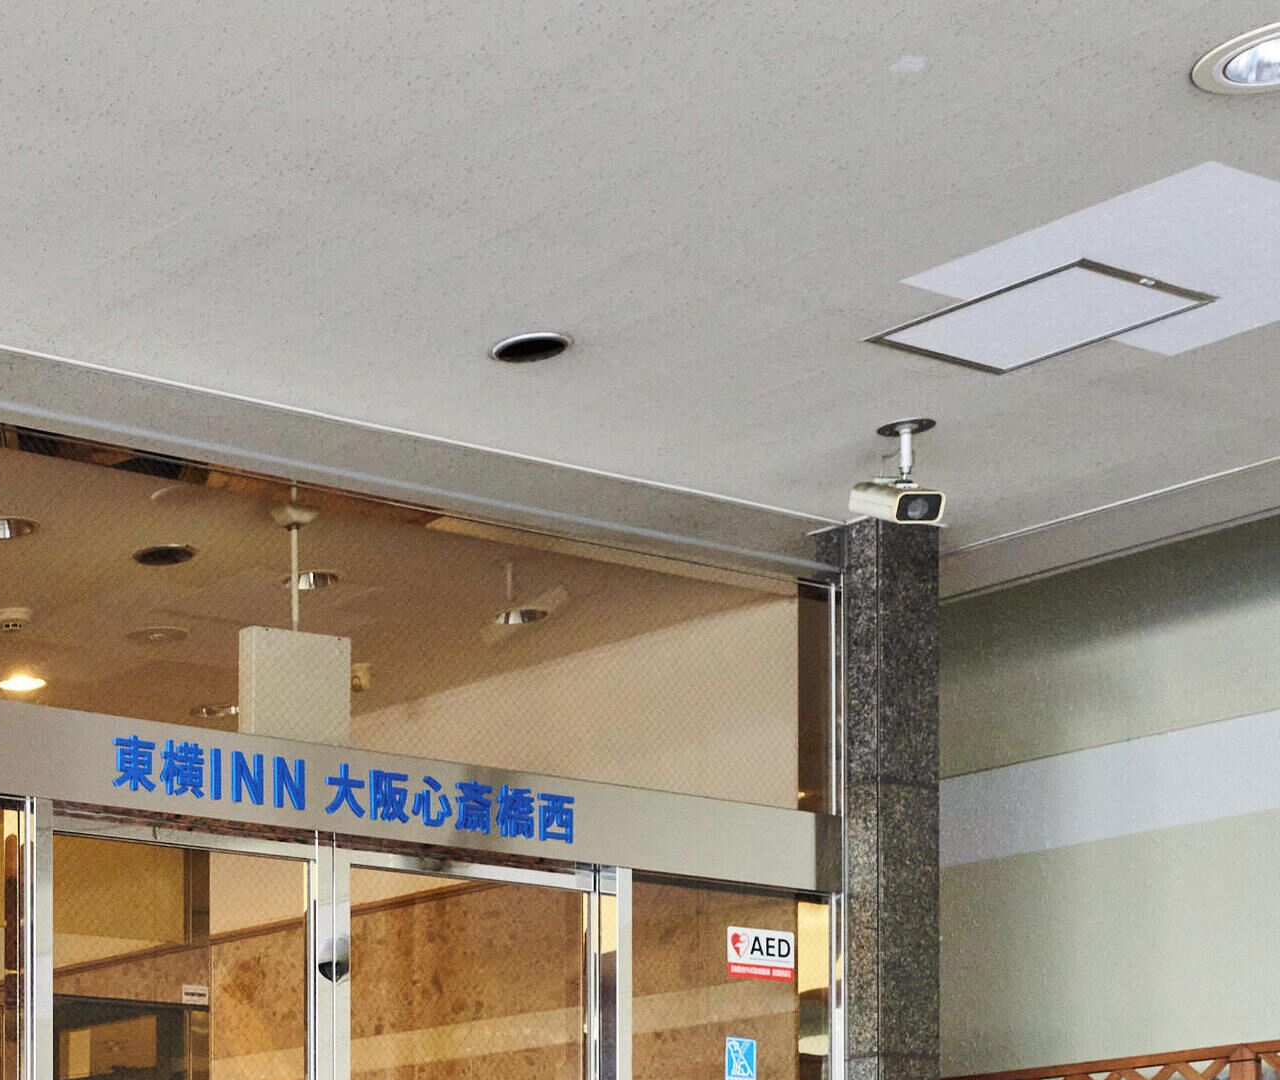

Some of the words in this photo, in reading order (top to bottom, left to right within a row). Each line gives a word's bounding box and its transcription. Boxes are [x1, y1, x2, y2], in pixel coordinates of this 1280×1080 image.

[112, 734, 307, 811] 東横INN
[324, 762, 577, 845] 大阪心斎橋西
[750, 936, 791, 958] AED
